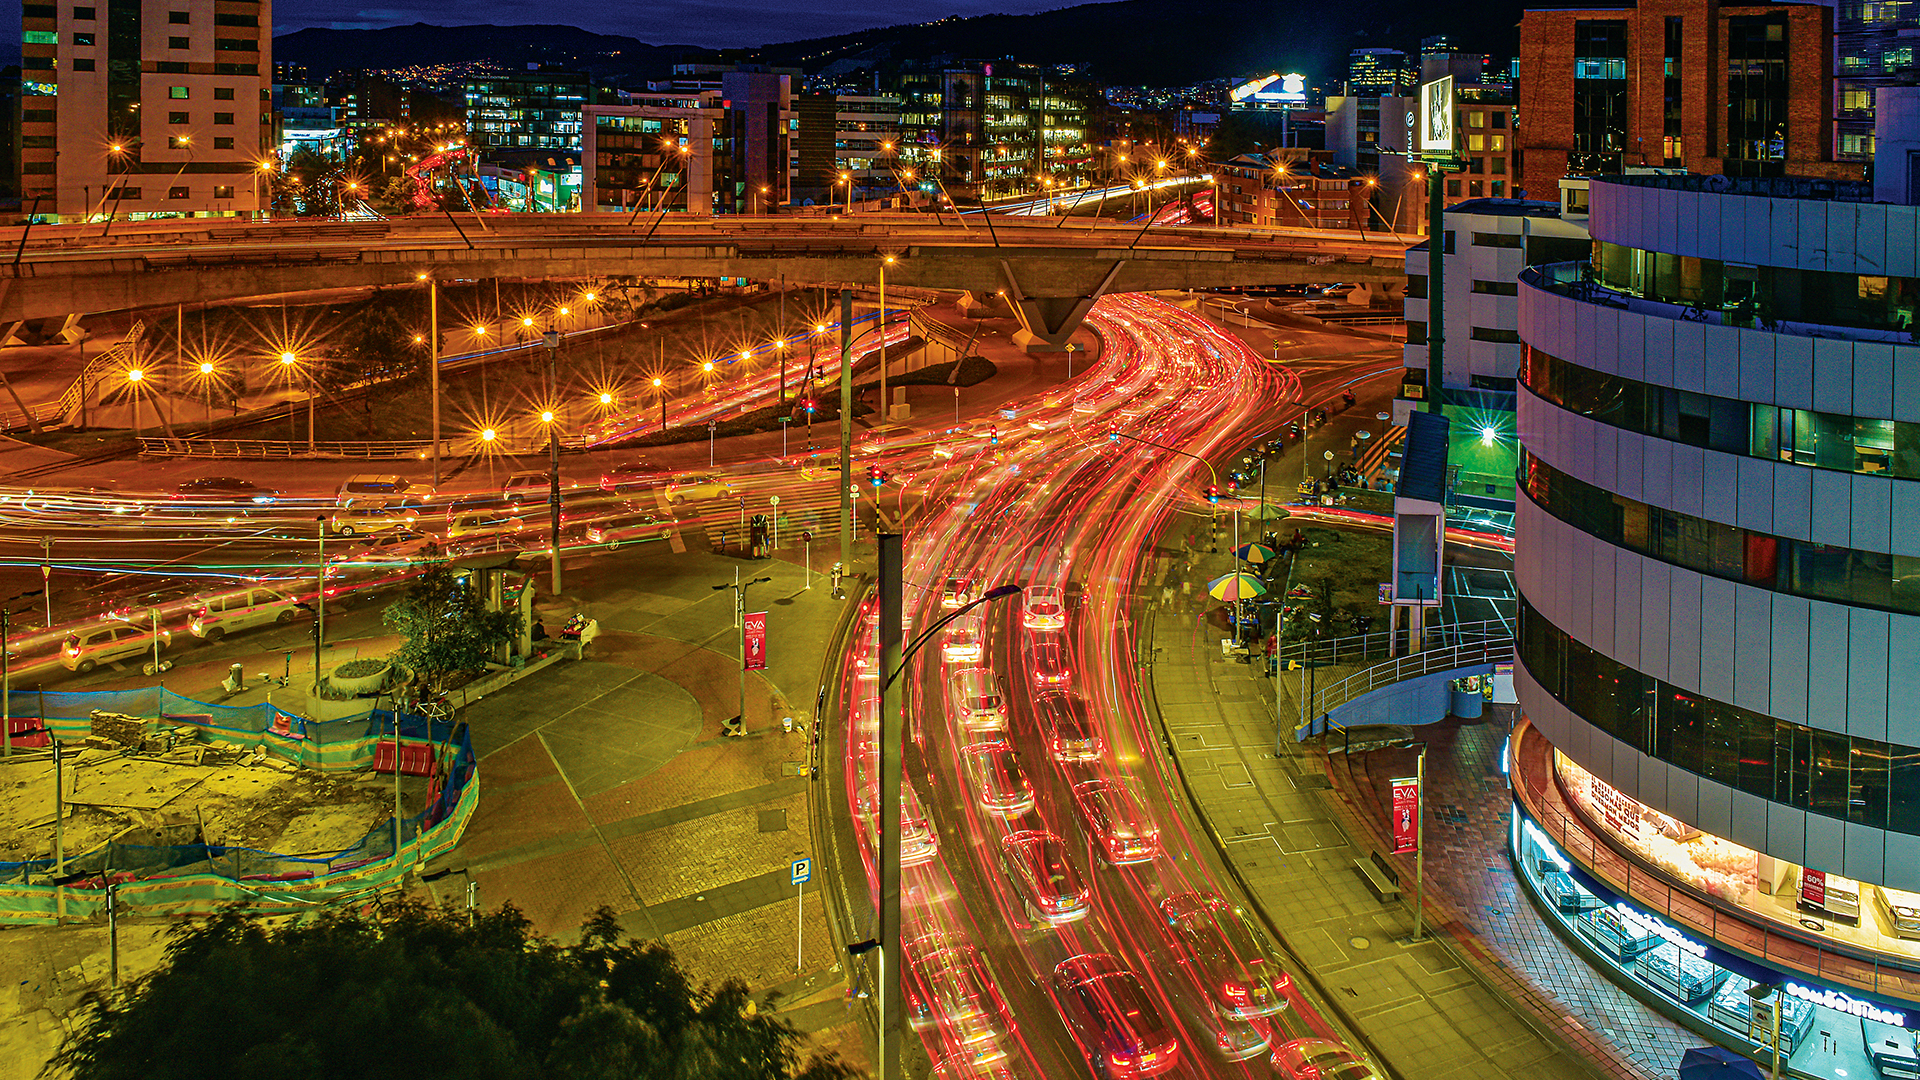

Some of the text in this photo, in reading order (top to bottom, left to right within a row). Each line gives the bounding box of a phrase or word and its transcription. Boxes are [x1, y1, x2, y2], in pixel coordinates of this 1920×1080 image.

[745, 621, 765, 629] EVA
[1393, 788, 1416, 798] EVA
[1591, 782, 1622, 811] PERSONAS
[1624, 808, 1640, 824] QUE
[1591, 791, 1640, 833] DUERMAN MEJOR
[796, 863, 805, 875] P
